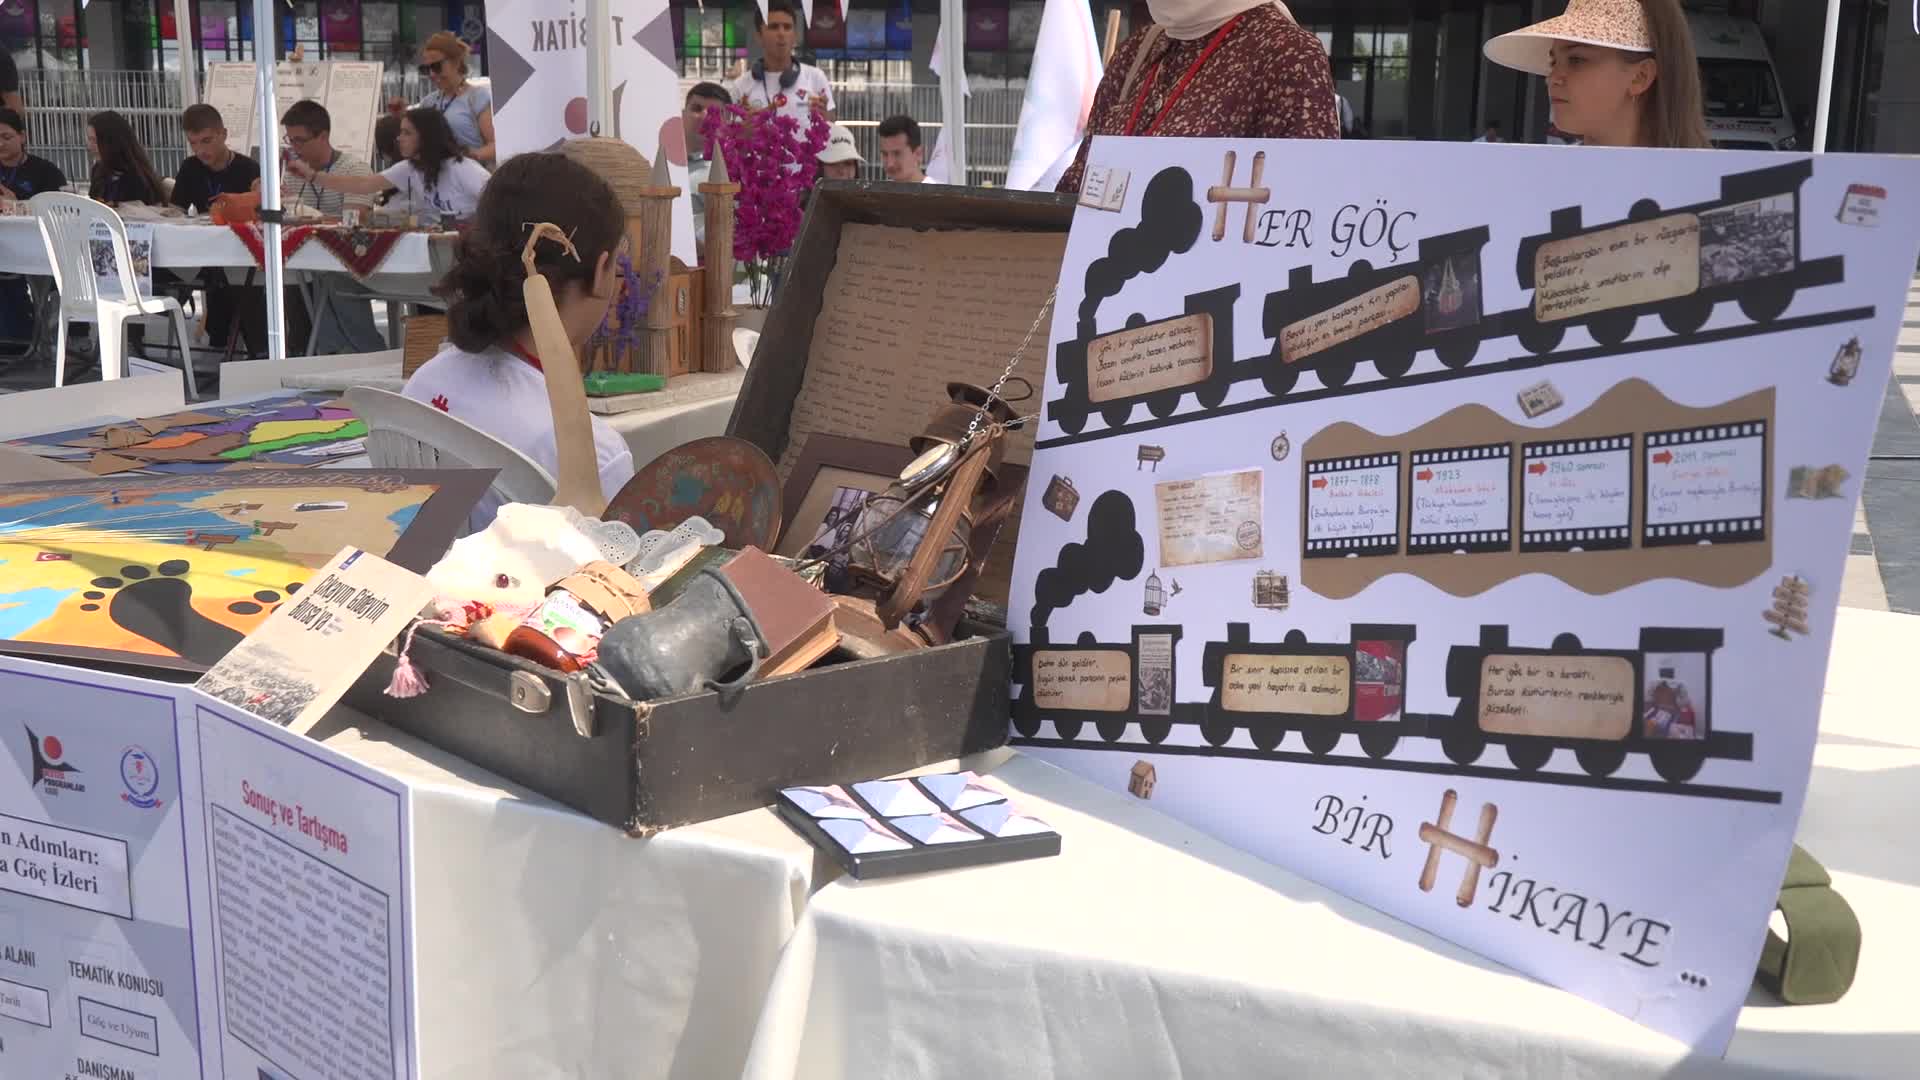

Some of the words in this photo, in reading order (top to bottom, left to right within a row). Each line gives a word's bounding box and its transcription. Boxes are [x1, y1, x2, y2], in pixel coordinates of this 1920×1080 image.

[1207, 150, 1312, 248] HER
[1330, 199, 1417, 263] GÖÇ
[1634, 231, 1649, 246] bir
[288, 597, 333, 631] Bursa'ya
[1231, 664, 1243, 674] Bir
[1332, 664, 1344, 676] bir
[1488, 664, 1504, 675] Her
[1506, 662, 1522, 682] göç
[1527, 666, 1541, 677] bir
[1487, 685, 1515, 697] Bursa
[242, 779, 277, 825] Sonuç
[280, 804, 294, 827] ve
[296, 804, 348, 854] Tartışma
[16, 831, 99, 866] Adımları:
[14, 858, 47, 887] Göç
[52, 861, 98, 894] İzleri
[1312, 794, 1393, 860] BİR
[1419, 789, 1671, 968] HİKAYE
[5, 945, 36, 968] ALANI
[68, 959, 116, 986] TEMATİK
[117, 971, 164, 998] KONUSU
[87, 1014, 106, 1030] Göç
[108, 1021, 119, 1032] ve
[121, 1023, 150, 1041] Uyum
